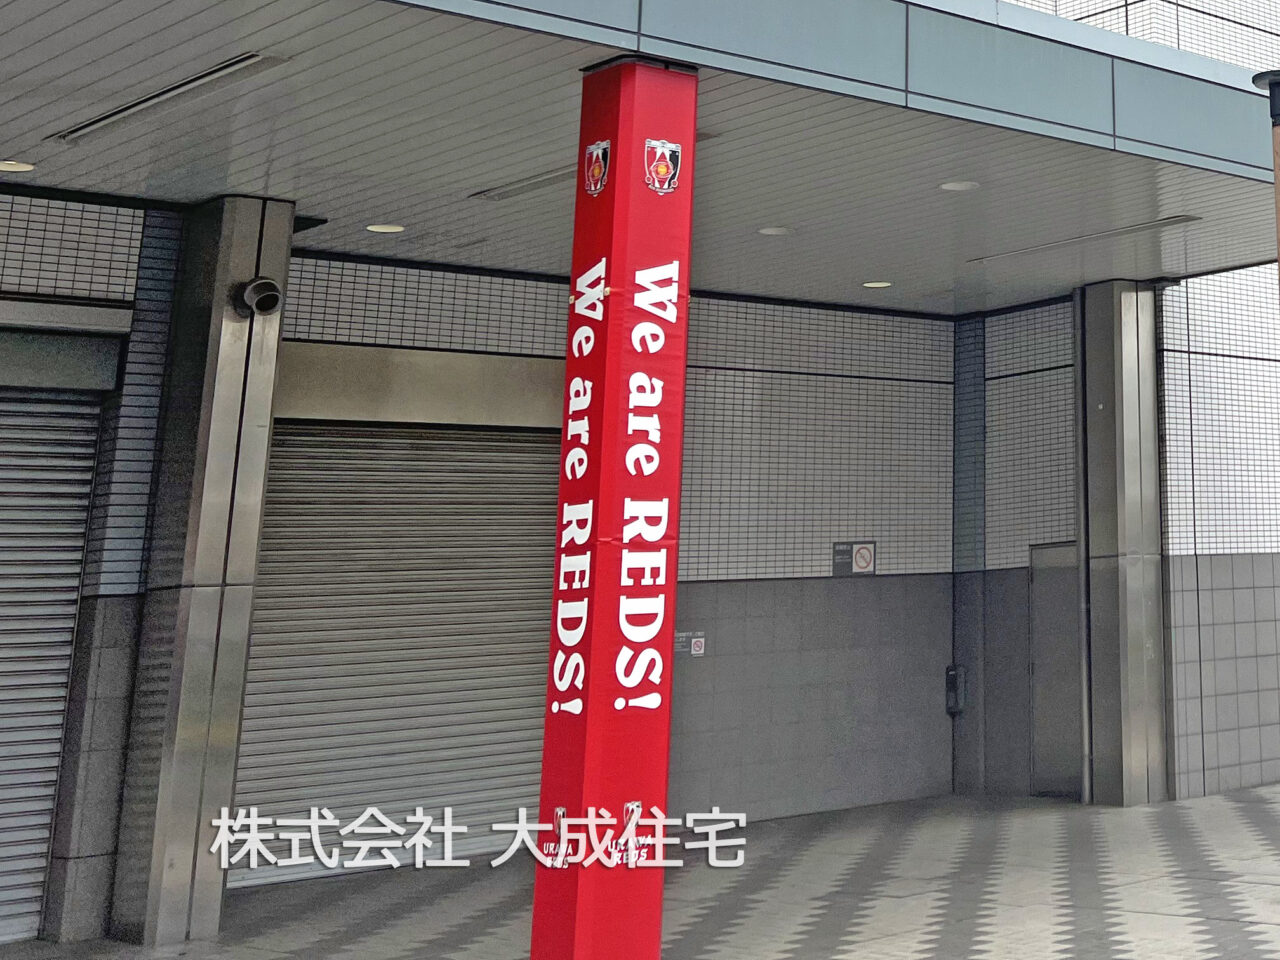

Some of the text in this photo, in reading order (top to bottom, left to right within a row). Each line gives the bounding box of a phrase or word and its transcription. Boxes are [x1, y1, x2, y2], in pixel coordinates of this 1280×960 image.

[551, 257, 607, 715] We are REDS!
[614, 260, 680, 711] We are REDS!
